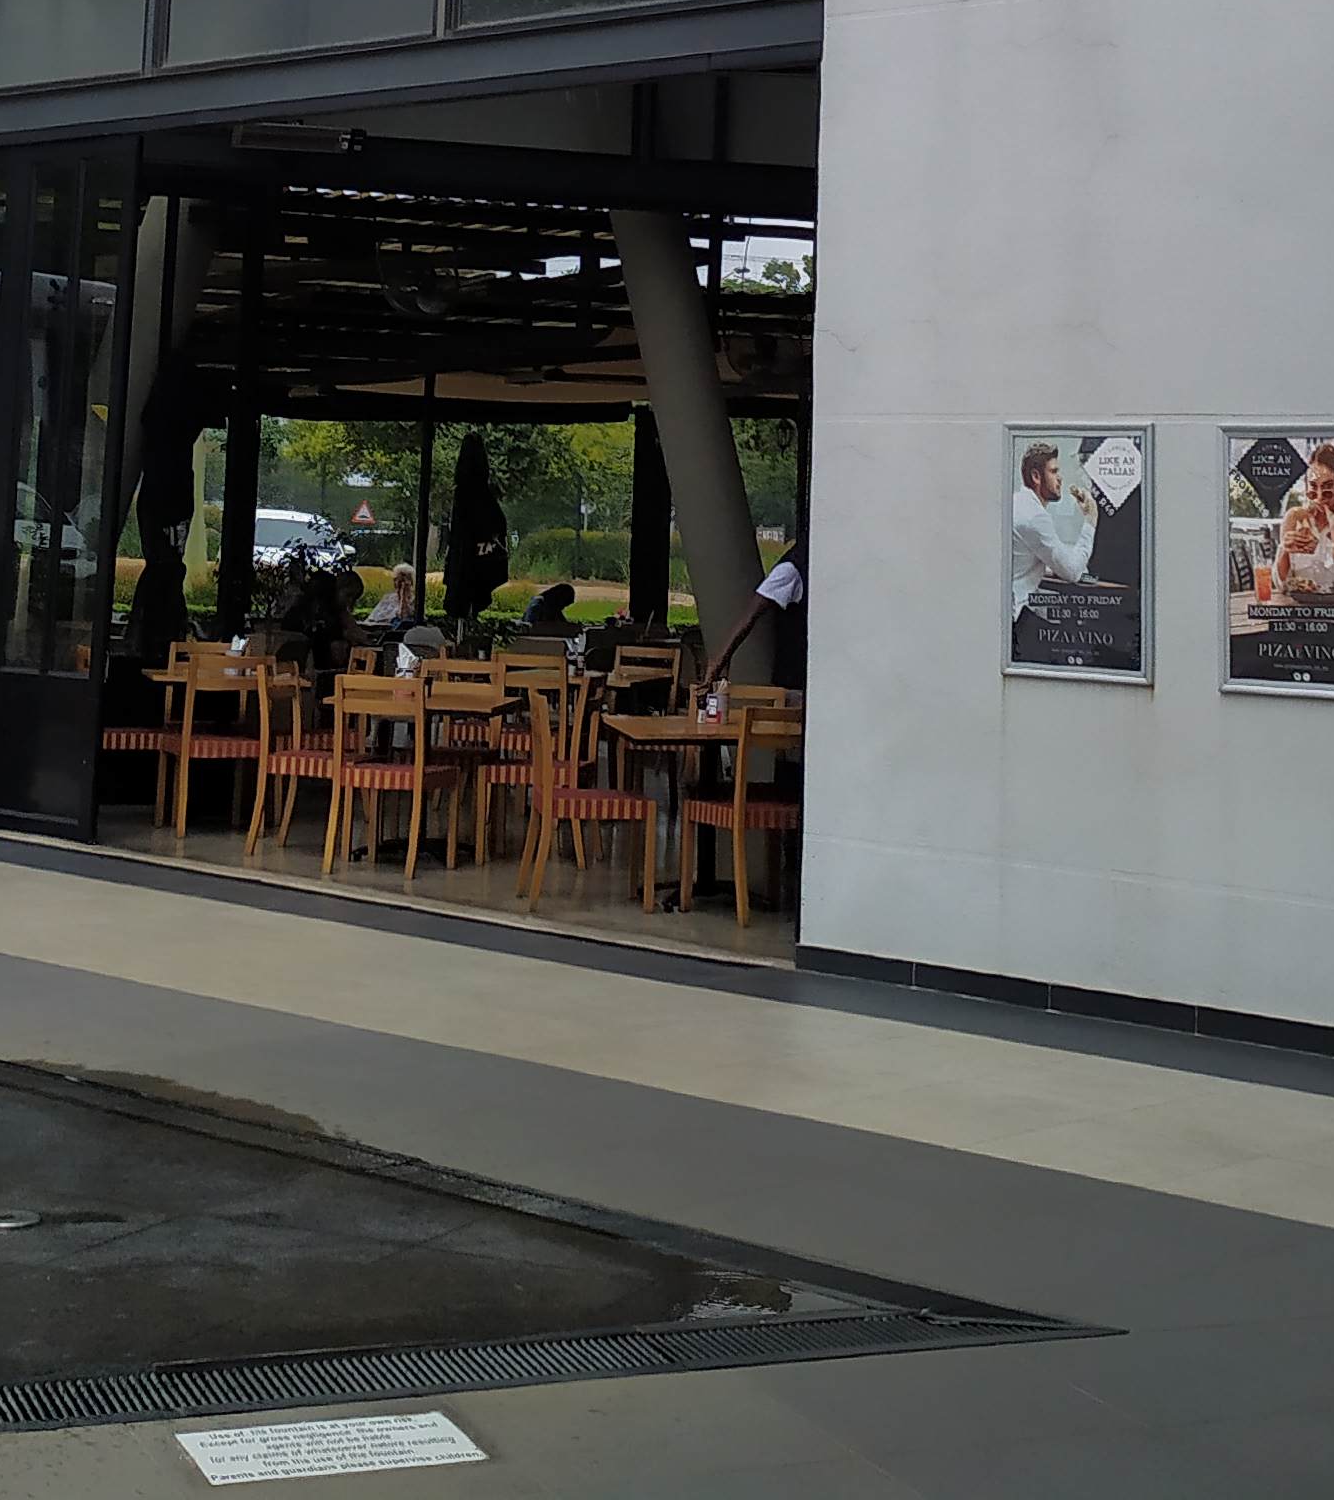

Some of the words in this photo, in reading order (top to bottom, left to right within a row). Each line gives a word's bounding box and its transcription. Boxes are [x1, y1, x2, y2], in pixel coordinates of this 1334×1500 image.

[1099, 456, 1120, 465] LIKE
[1122, 456, 1135, 466] AN
[1252, 454, 1275, 464] LIKE
[1277, 454, 1292, 464] AN
[1098, 467, 1135, 476] ITALIAN
[1251, 466, 1292, 476] ITALIAN
[1029, 594, 1068, 605] MONDAY
[1070, 595, 1086, 605] TO
[1087, 596, 1123, 606] FRIDAY
[1249, 606, 1292, 617] MONDAY
[1295, 607, 1312, 617] TO
[1039, 629, 1069, 643] PIZA
[1078, 631, 1114, 645] VINO
[1258, 642, 1295, 658] PIZA
[269, 1425, 315, 1435] fountain
[210, 1471, 255, 1481] Parents
[258, 1468, 279, 1477] and
[281, 1464, 337, 1476] guardians
[340, 1459, 376, 1470] please
[379, 1455, 432, 1466] supervise
